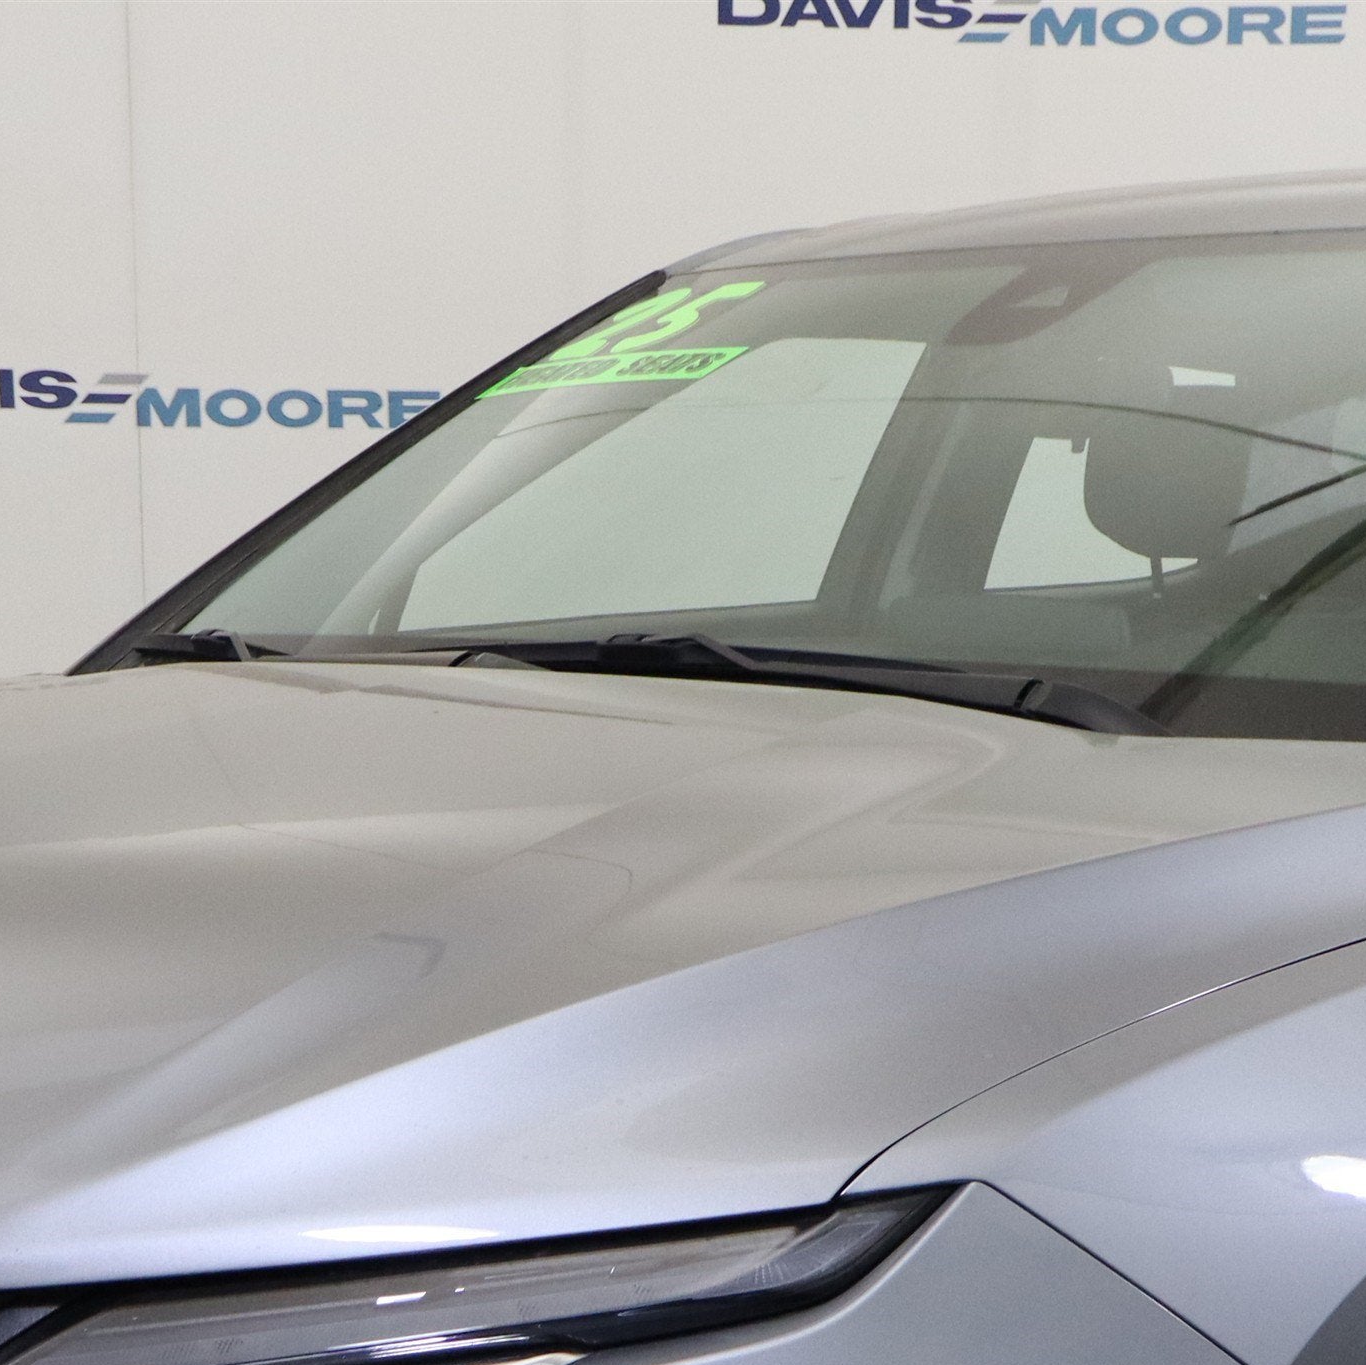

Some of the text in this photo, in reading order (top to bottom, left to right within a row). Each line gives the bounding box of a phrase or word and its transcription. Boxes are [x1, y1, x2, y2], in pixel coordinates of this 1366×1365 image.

[718, 0, 1346, 46] DAVIS MOORE
[550, 281, 766, 361] 25
[615, 352, 727, 377] SEATS
